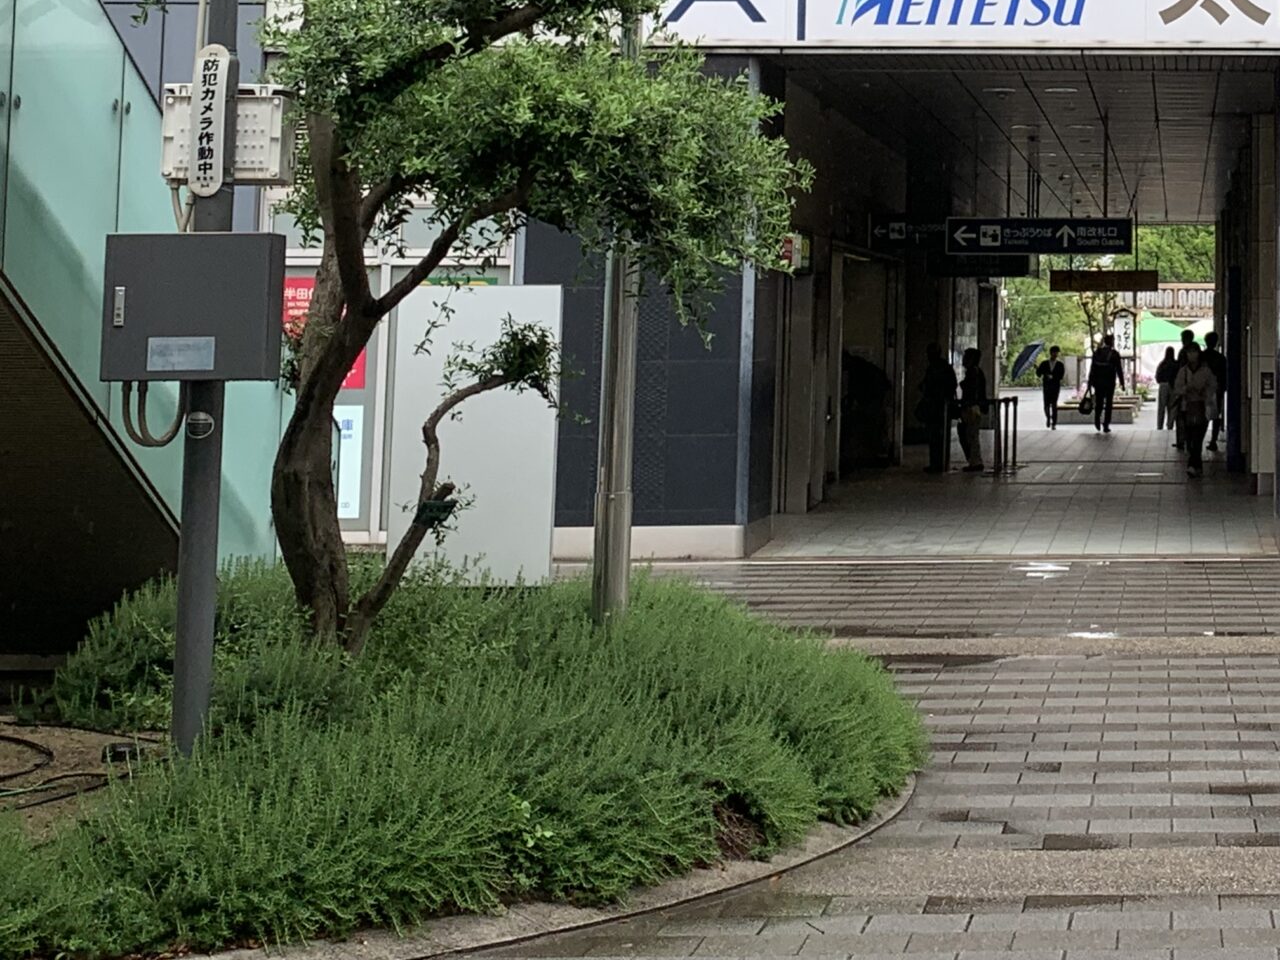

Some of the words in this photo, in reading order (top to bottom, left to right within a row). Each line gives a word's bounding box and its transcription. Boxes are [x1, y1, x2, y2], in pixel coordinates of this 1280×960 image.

[198, 58, 220, 175] 防犯カメラ作動中
[1003, 227, 1053, 238] きっぷうりば
[1076, 227, 1118, 237] 南改札口
